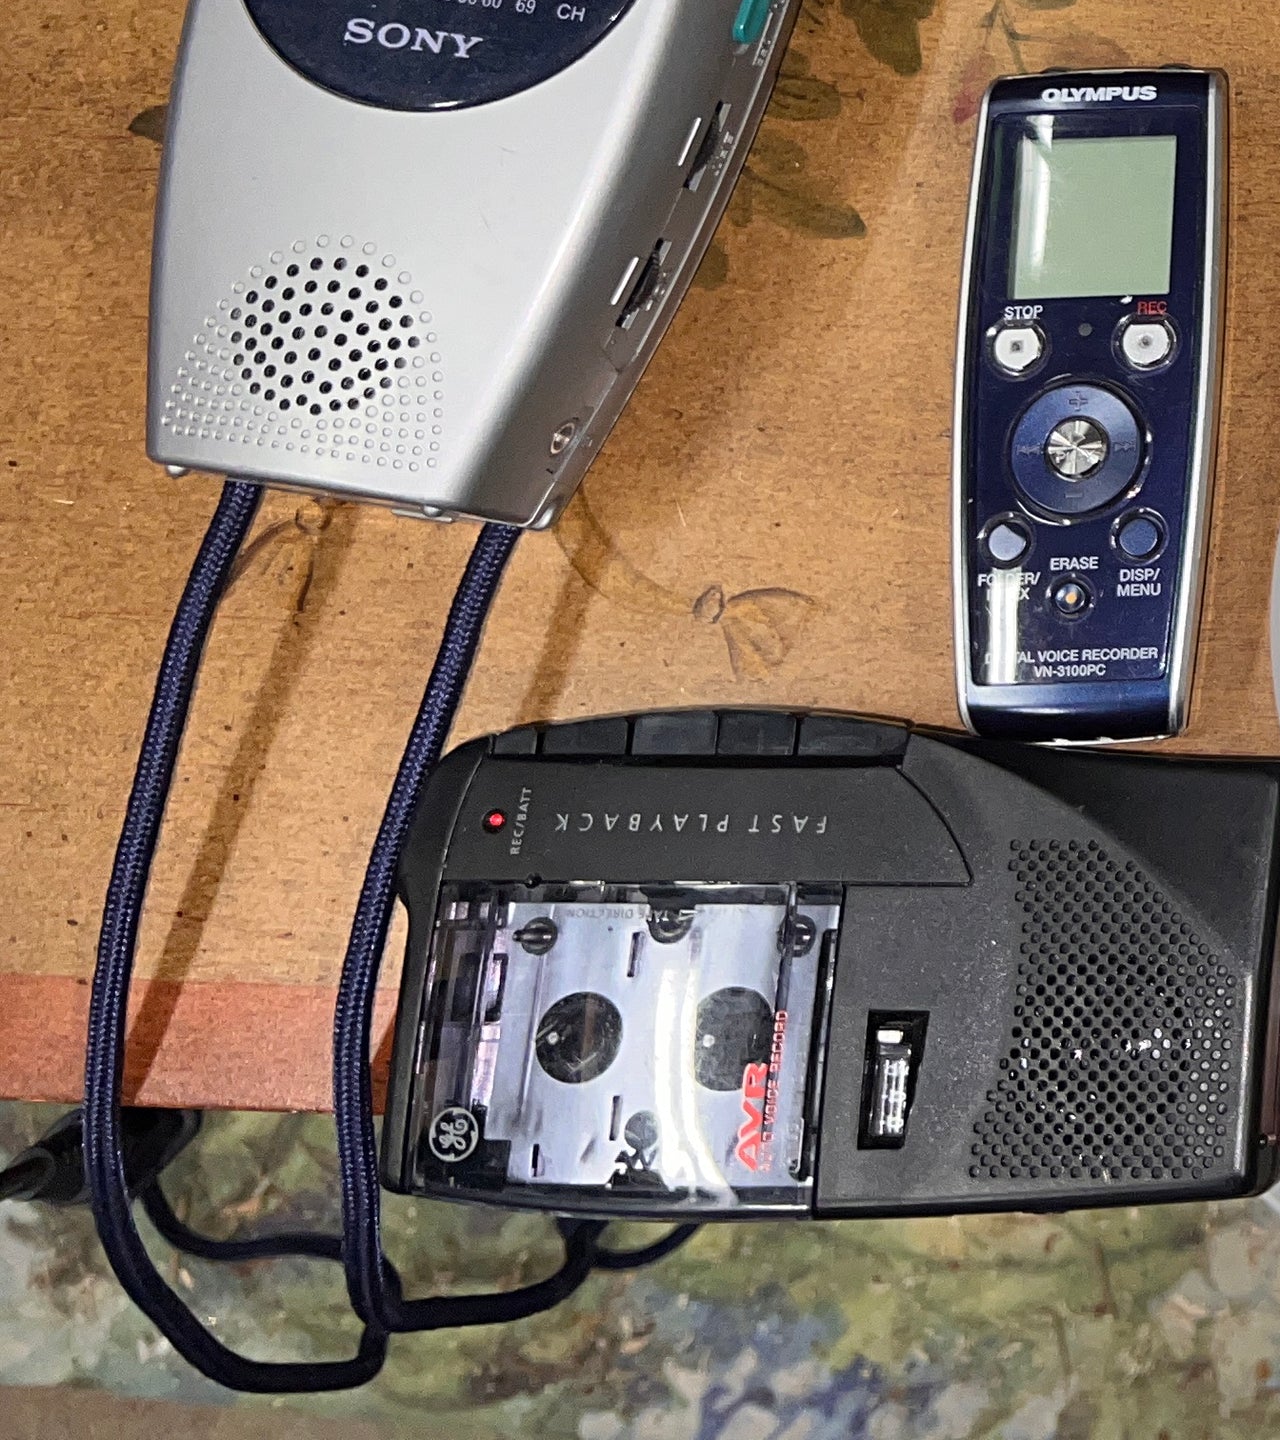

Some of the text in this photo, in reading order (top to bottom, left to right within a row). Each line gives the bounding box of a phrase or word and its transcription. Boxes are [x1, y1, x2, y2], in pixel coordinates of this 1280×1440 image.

[556, 3, 586, 22] CH
[344, 17, 483, 59] SONY
[1041, 86, 1157, 102] OLYMPUS
[1004, 305, 1043, 320] STOP
[1137, 301, 1167, 315] REC
[1050, 557, 1099, 570] ERASE
[1119, 568, 1160, 582] DISP/
[1116, 583, 1161, 597] MENU
[1037, 650, 1079, 662] VOICE
[1082, 647, 1158, 661] RECORDER
[1033, 664, 1106, 677] VN-3100PC
[510, 787, 532, 857] REC/BATT
[554, 813, 827, 835] FAST PLAYBACK
[768, 1009, 788, 1072] RECORD
[734, 1063, 768, 1172] AVR
